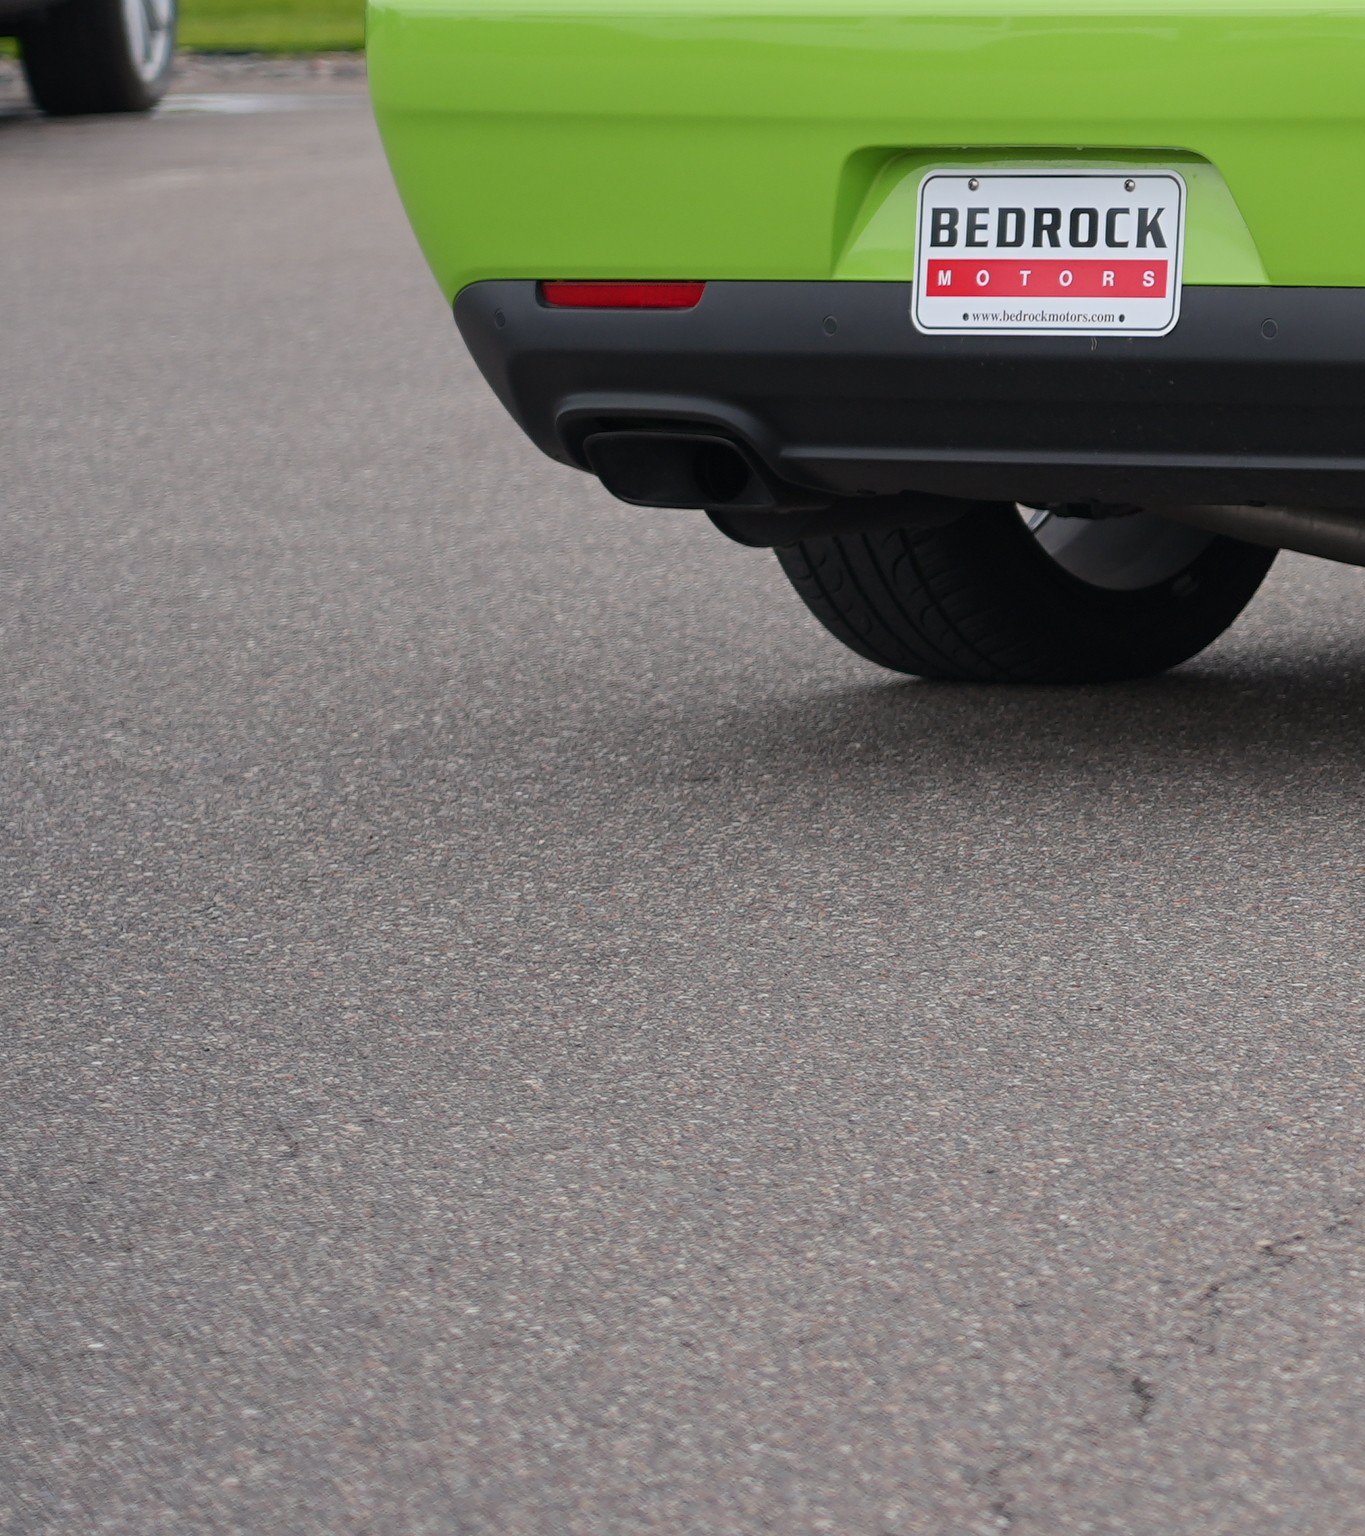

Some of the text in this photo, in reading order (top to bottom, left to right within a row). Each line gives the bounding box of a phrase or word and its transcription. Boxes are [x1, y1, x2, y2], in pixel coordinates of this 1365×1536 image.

[929, 207, 1168, 248] BEDROCK
[937, 269, 1155, 288] MOTORS
[972, 310, 1115, 323] www.bedrockmotors.com
